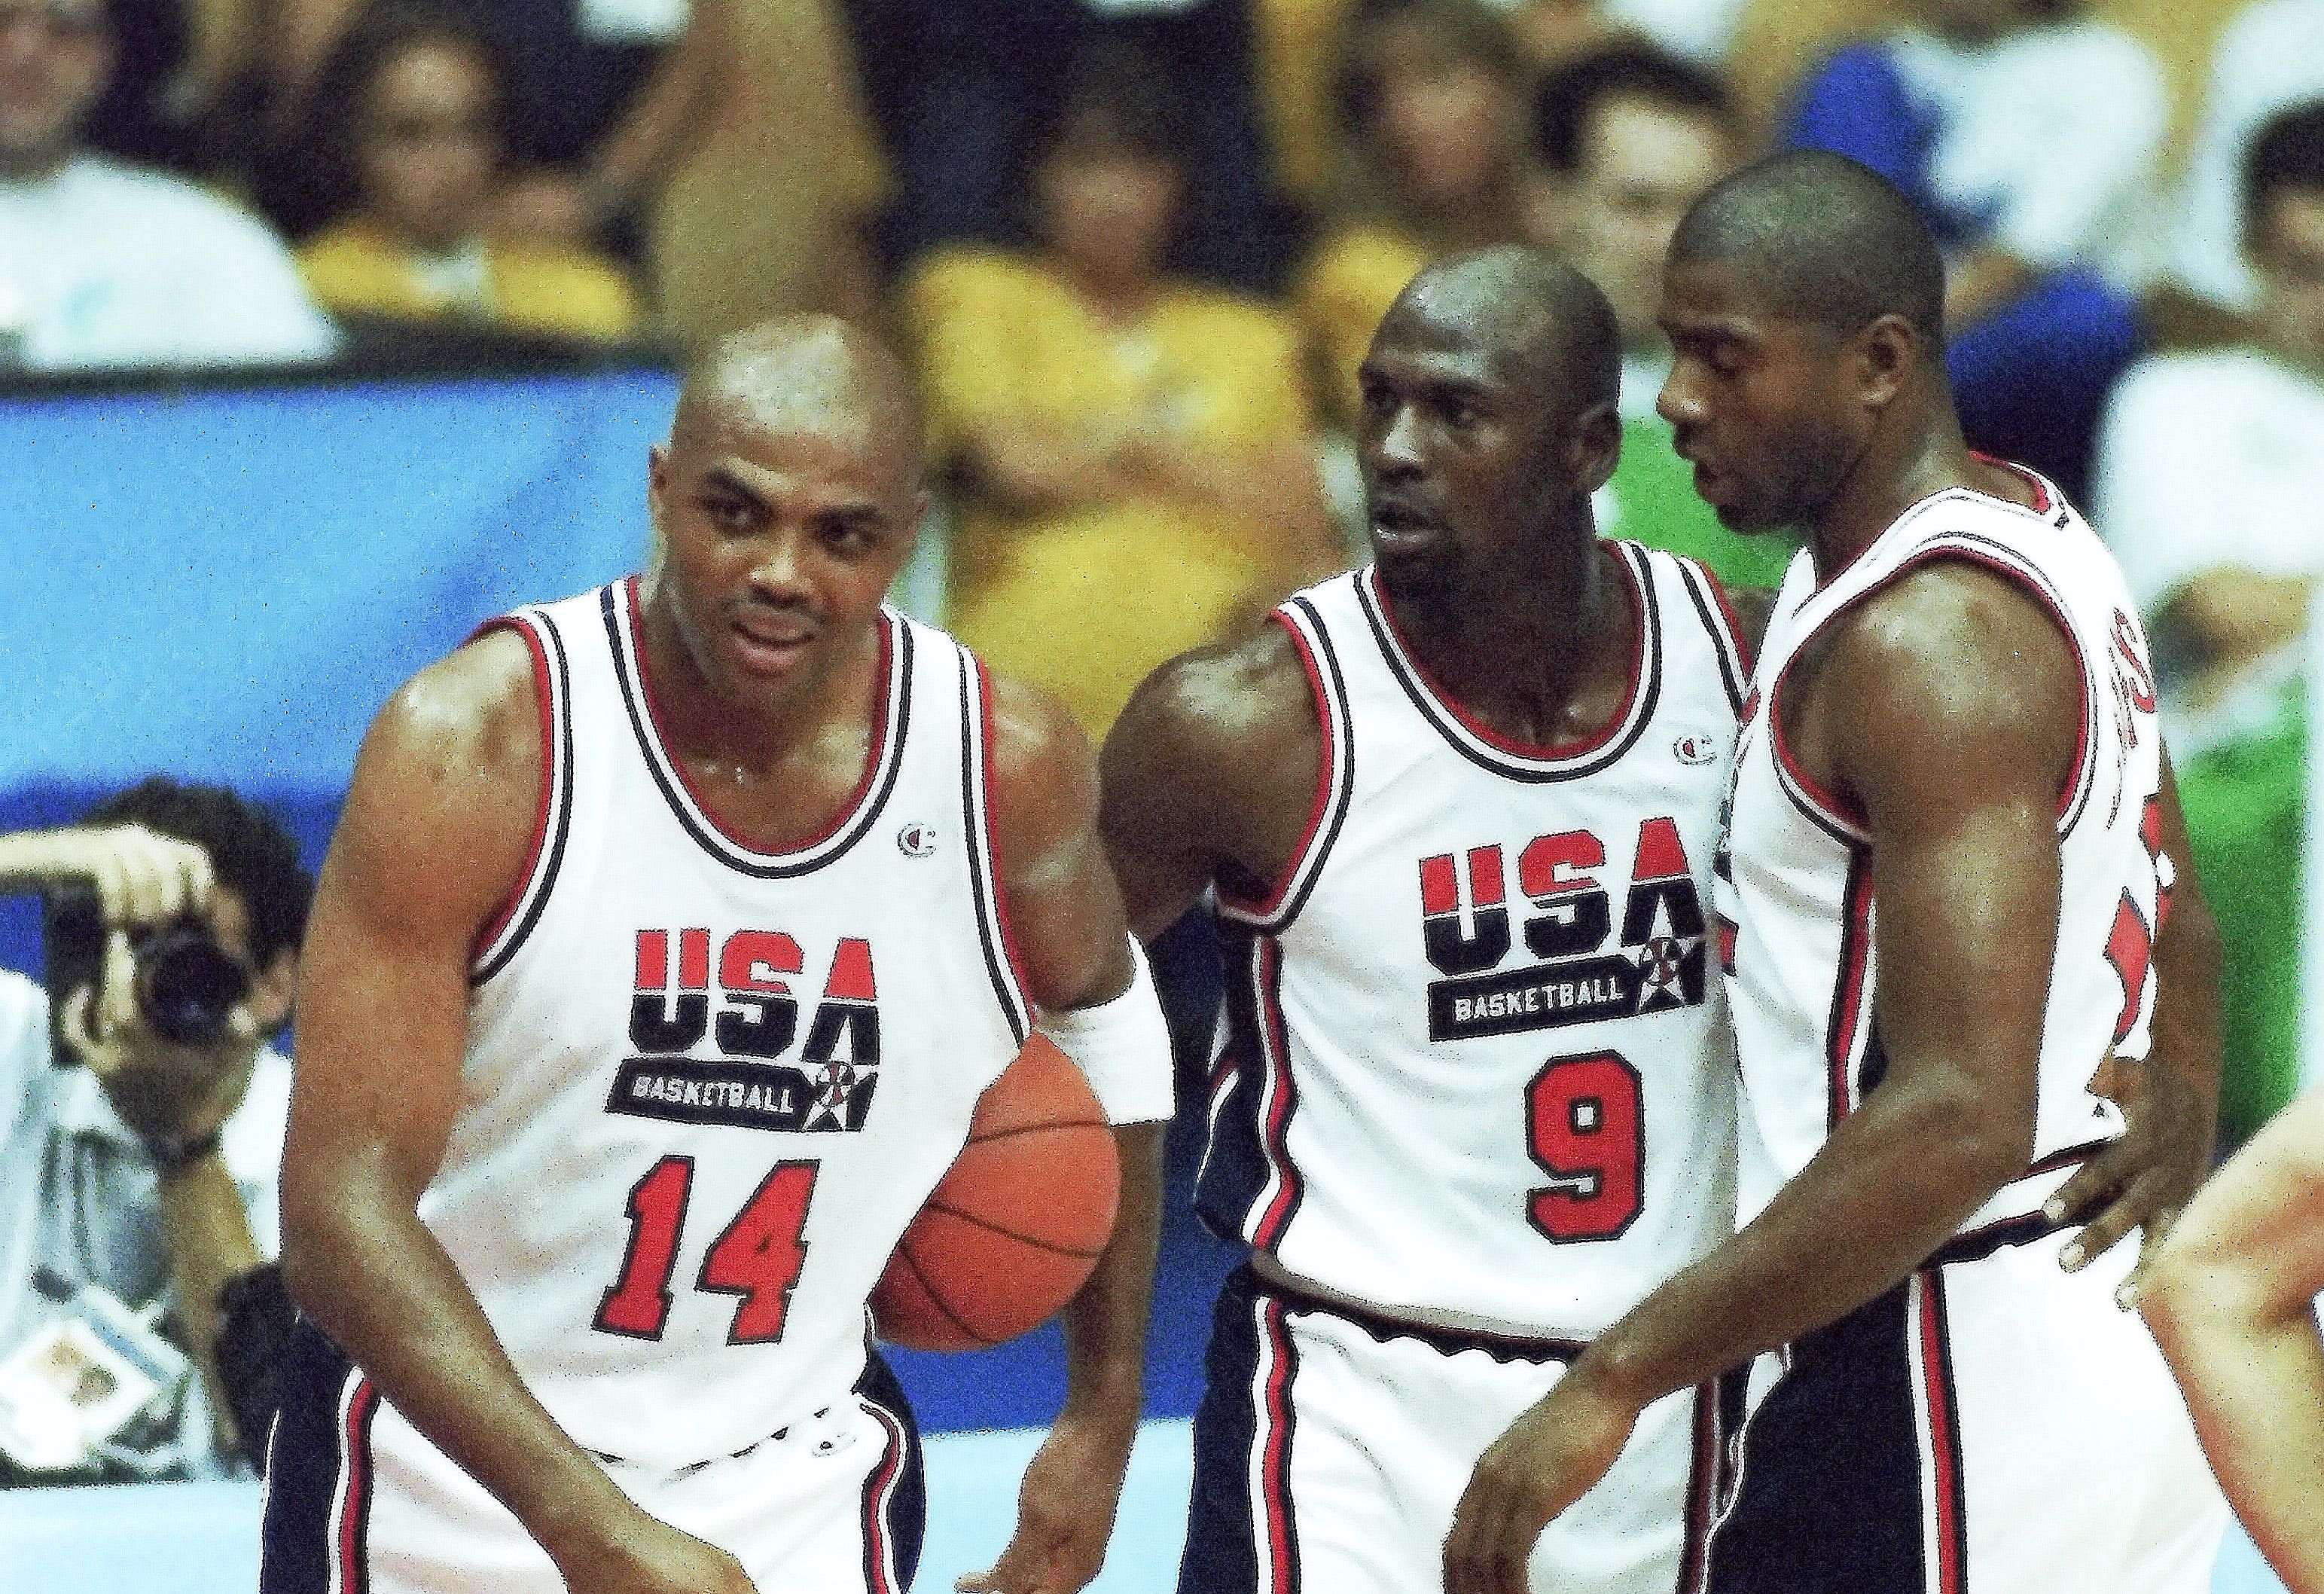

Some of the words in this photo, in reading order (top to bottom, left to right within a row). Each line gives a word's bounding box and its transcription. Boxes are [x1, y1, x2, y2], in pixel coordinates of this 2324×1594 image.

[1419, 817, 1704, 976] USA
[629, 928, 880, 1064] USA
[1454, 976, 1624, 1021] BASKETBALL
[633, 1076, 795, 1113] BASKETBALL
[1524, 1049, 1645, 1244] 9
[590, 1154, 821, 1345] 14
